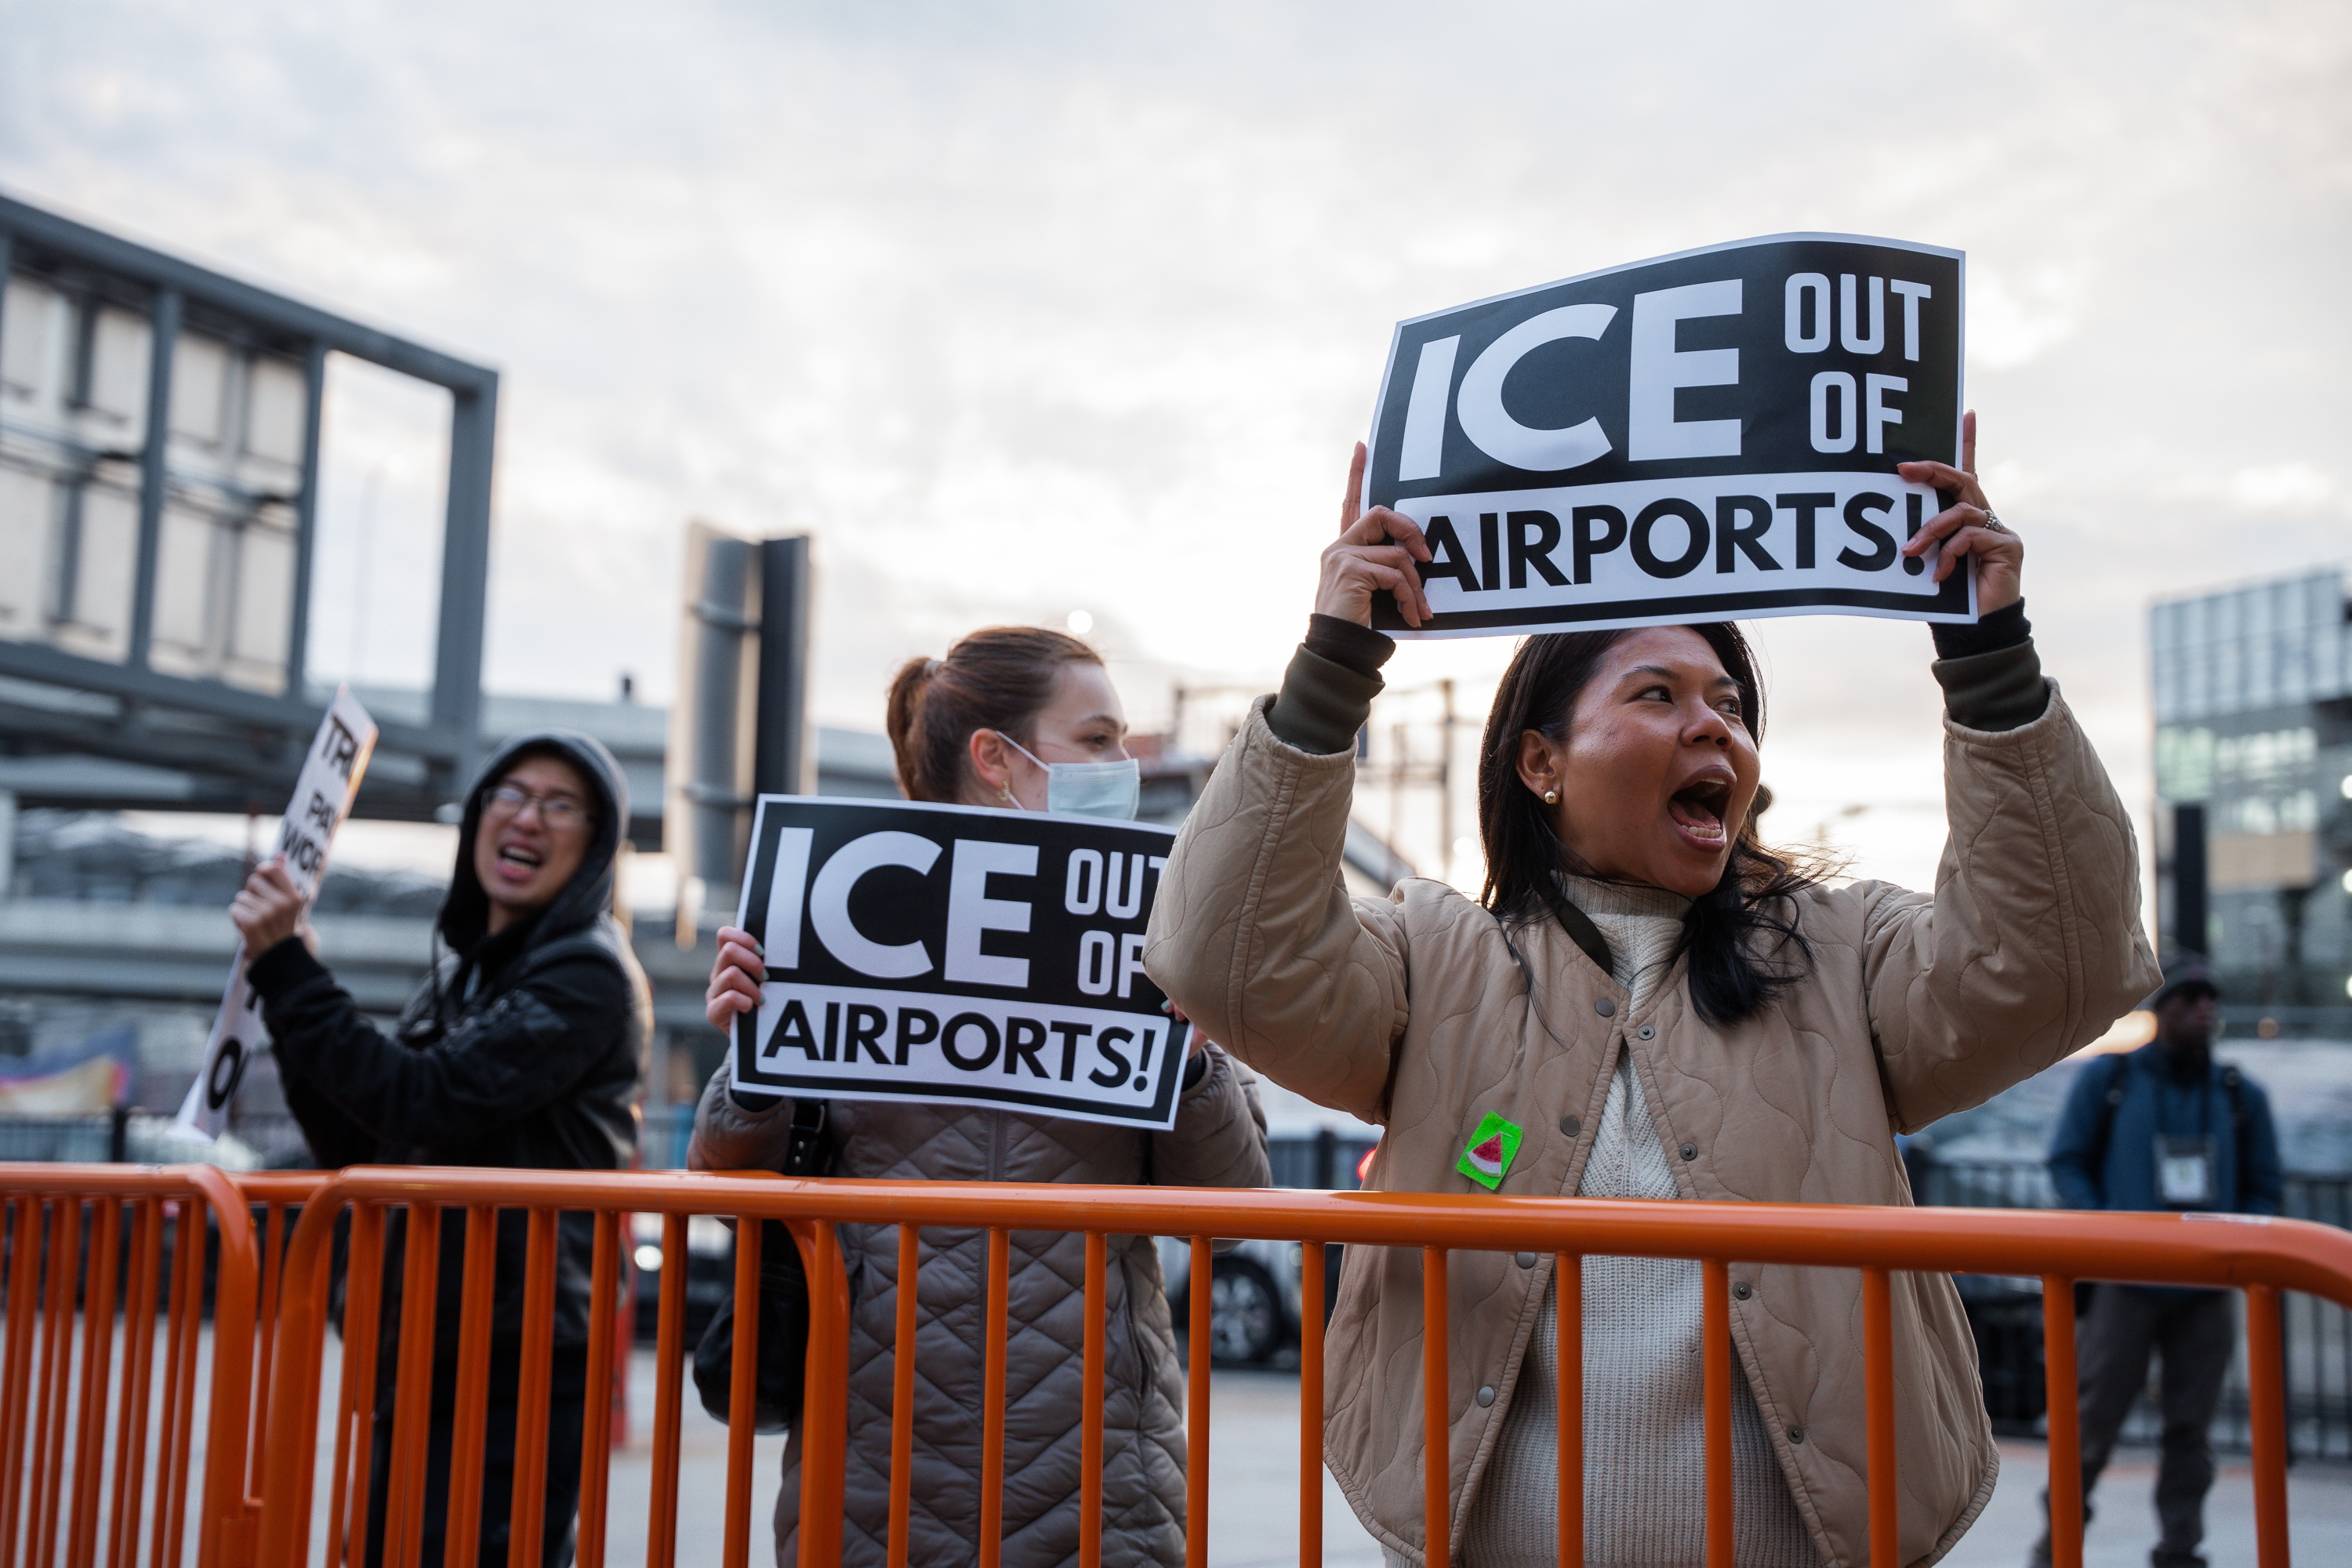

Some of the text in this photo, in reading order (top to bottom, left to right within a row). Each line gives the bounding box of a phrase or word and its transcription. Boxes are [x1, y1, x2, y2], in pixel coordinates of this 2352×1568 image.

[1784, 272, 1931, 362] OUT
[1399, 278, 1743, 481] ICE
[1810, 371, 1908, 454] OF
[1414, 492, 1925, 593] AIRPORTS!
[322, 714, 359, 779] TR
[764, 827, 1040, 988] ICE
[1077, 930, 1146, 999] OF
[762, 1000, 1156, 1092] AIRPORTS!
